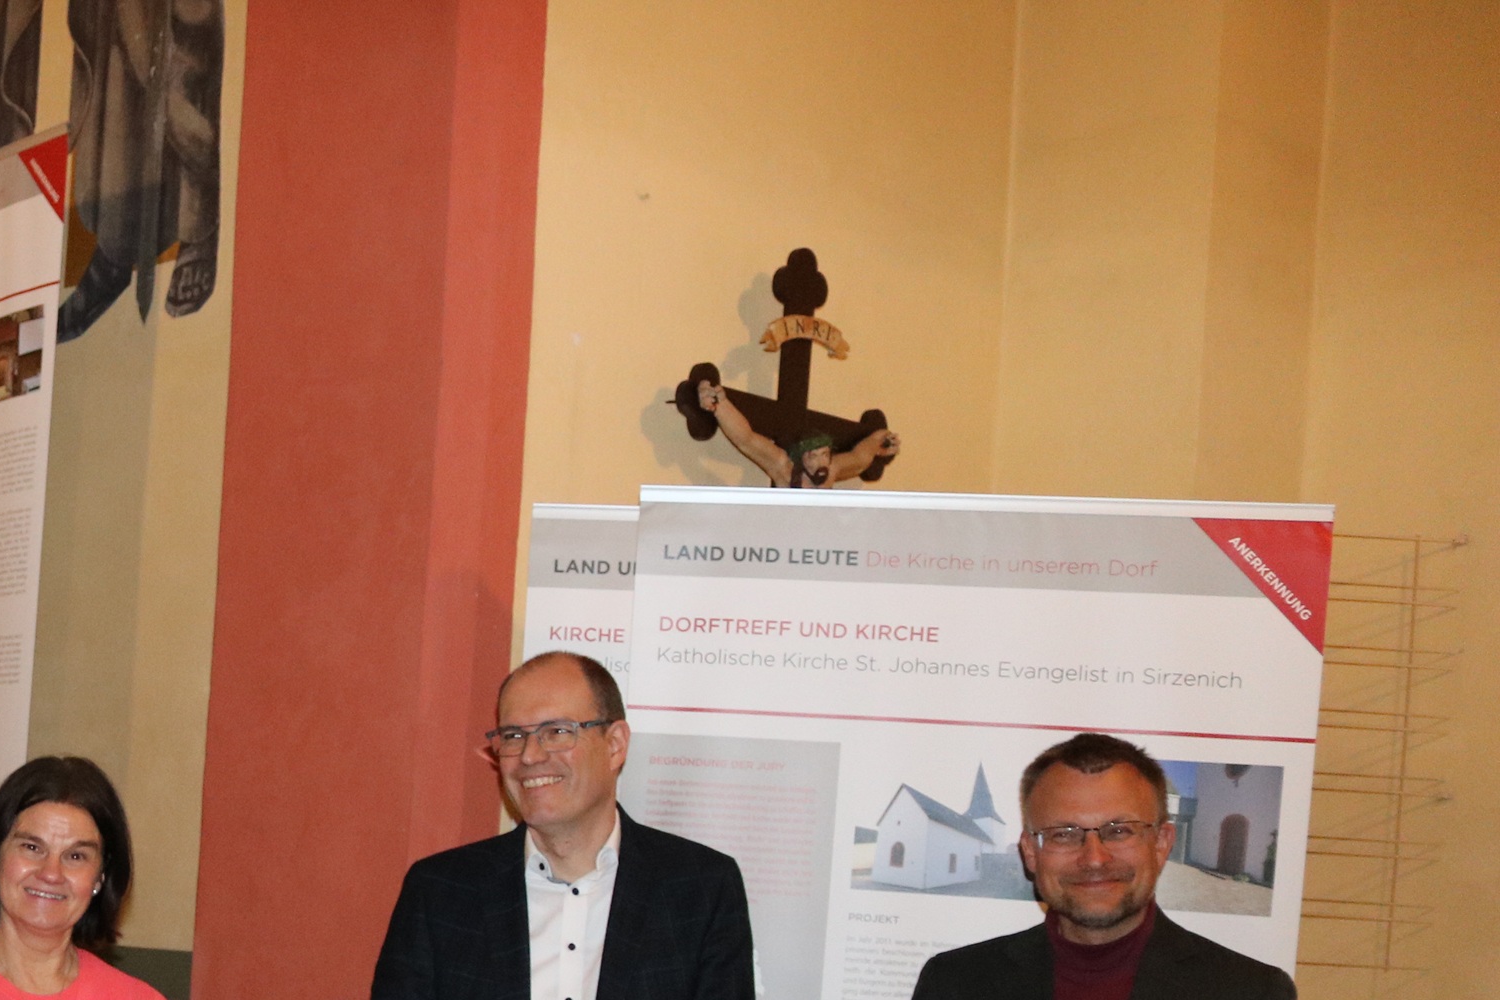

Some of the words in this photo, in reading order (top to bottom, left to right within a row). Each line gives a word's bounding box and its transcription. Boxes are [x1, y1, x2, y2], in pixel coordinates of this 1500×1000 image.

[554, 559, 611, 575] LAND
[663, 544, 724, 562] LAND
[733, 547, 780, 564] UND
[788, 548, 859, 566] LEUTE
[866, 551, 901, 568] Die
[908, 553, 974, 571] Kirche
[982, 555, 1000, 572] in
[1008, 560, 1100, 576] unserem
[1108, 559, 1158, 577] Dorf
[1228, 536, 1312, 621] ANERKENNUNG
[549, 626, 625, 643] KIRCHE
[659, 616, 792, 636] DORFTREFF
[800, 621, 847, 639] UND
[856, 624, 939, 643] KIRCHE
[657, 647, 775, 667] Katholische
[783, 652, 849, 671] Kirche
[855, 654, 881, 673] St.
[889, 657, 990, 678] Johannes
[998, 661, 1108, 684] Evangelist
[1116, 667, 1134, 684] in
[1143, 667, 1243, 689] Sirzenich
[848, 912, 900, 925] PROJEKT
